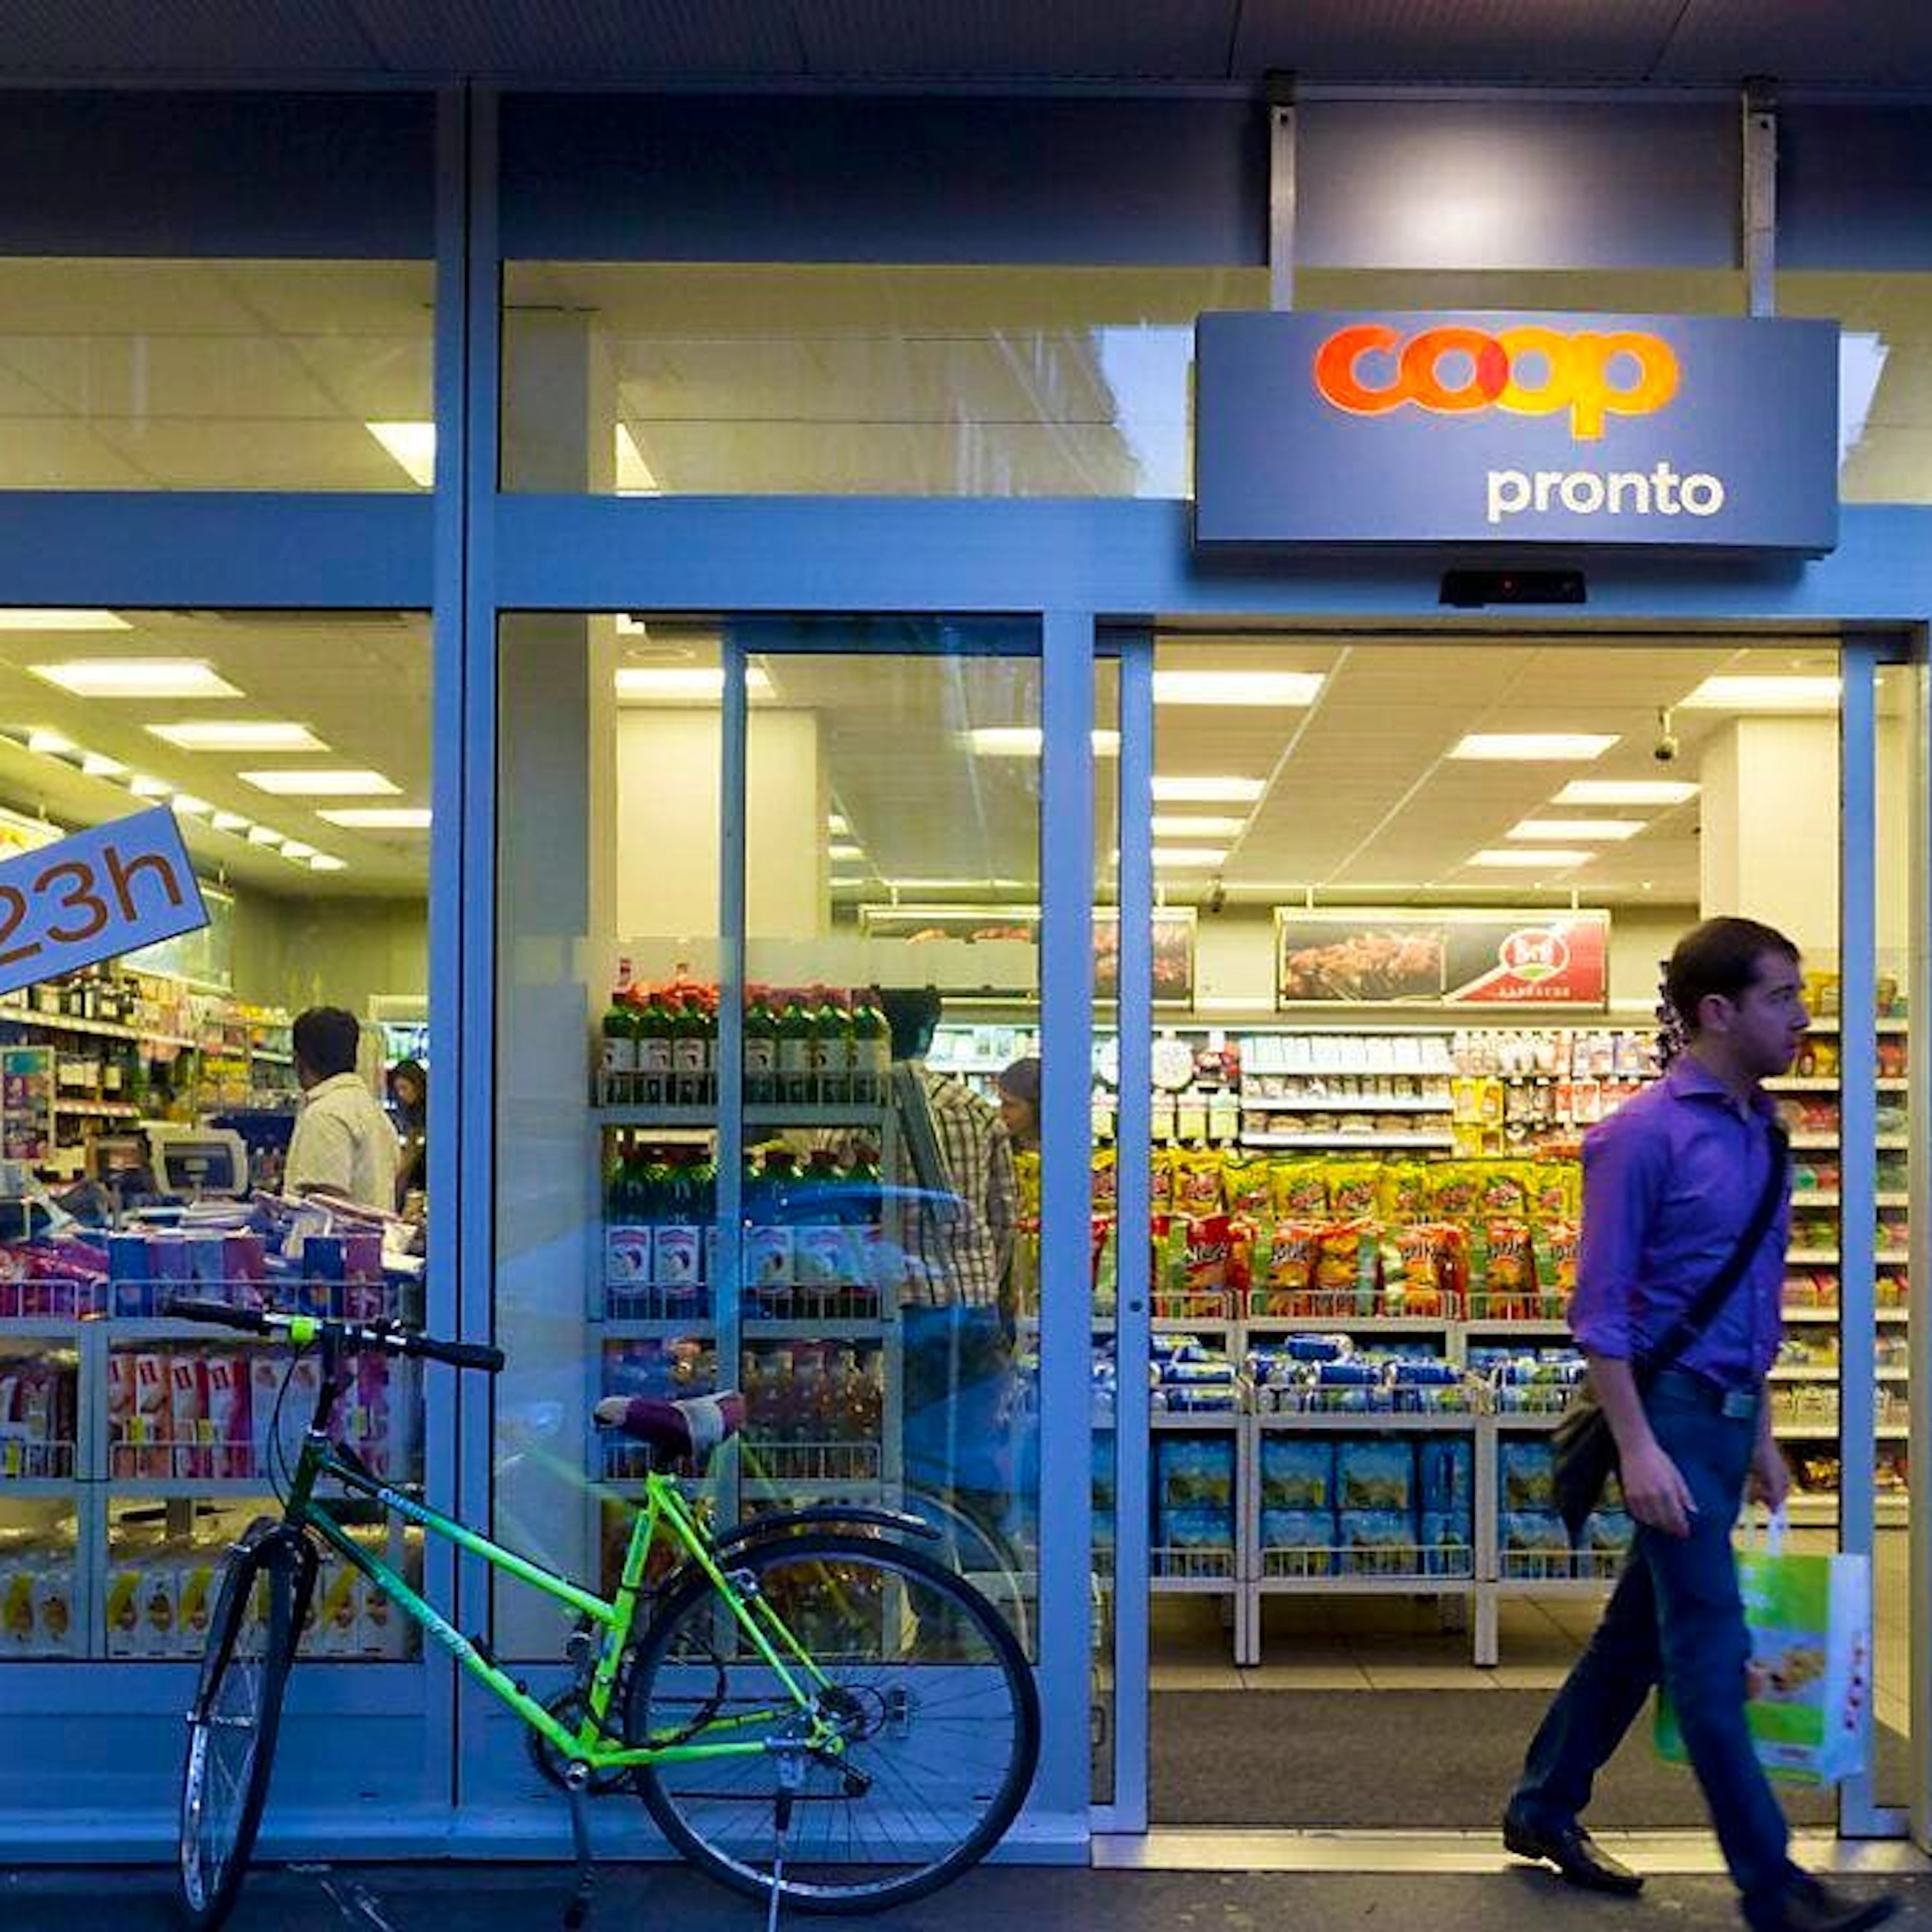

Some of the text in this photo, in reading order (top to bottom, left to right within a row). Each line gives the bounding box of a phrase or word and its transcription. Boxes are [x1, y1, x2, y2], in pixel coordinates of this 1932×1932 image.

[1314, 324, 1679, 441] coop
[1487, 462, 1724, 523] pronto
[0, 845, 183, 965] 23h
